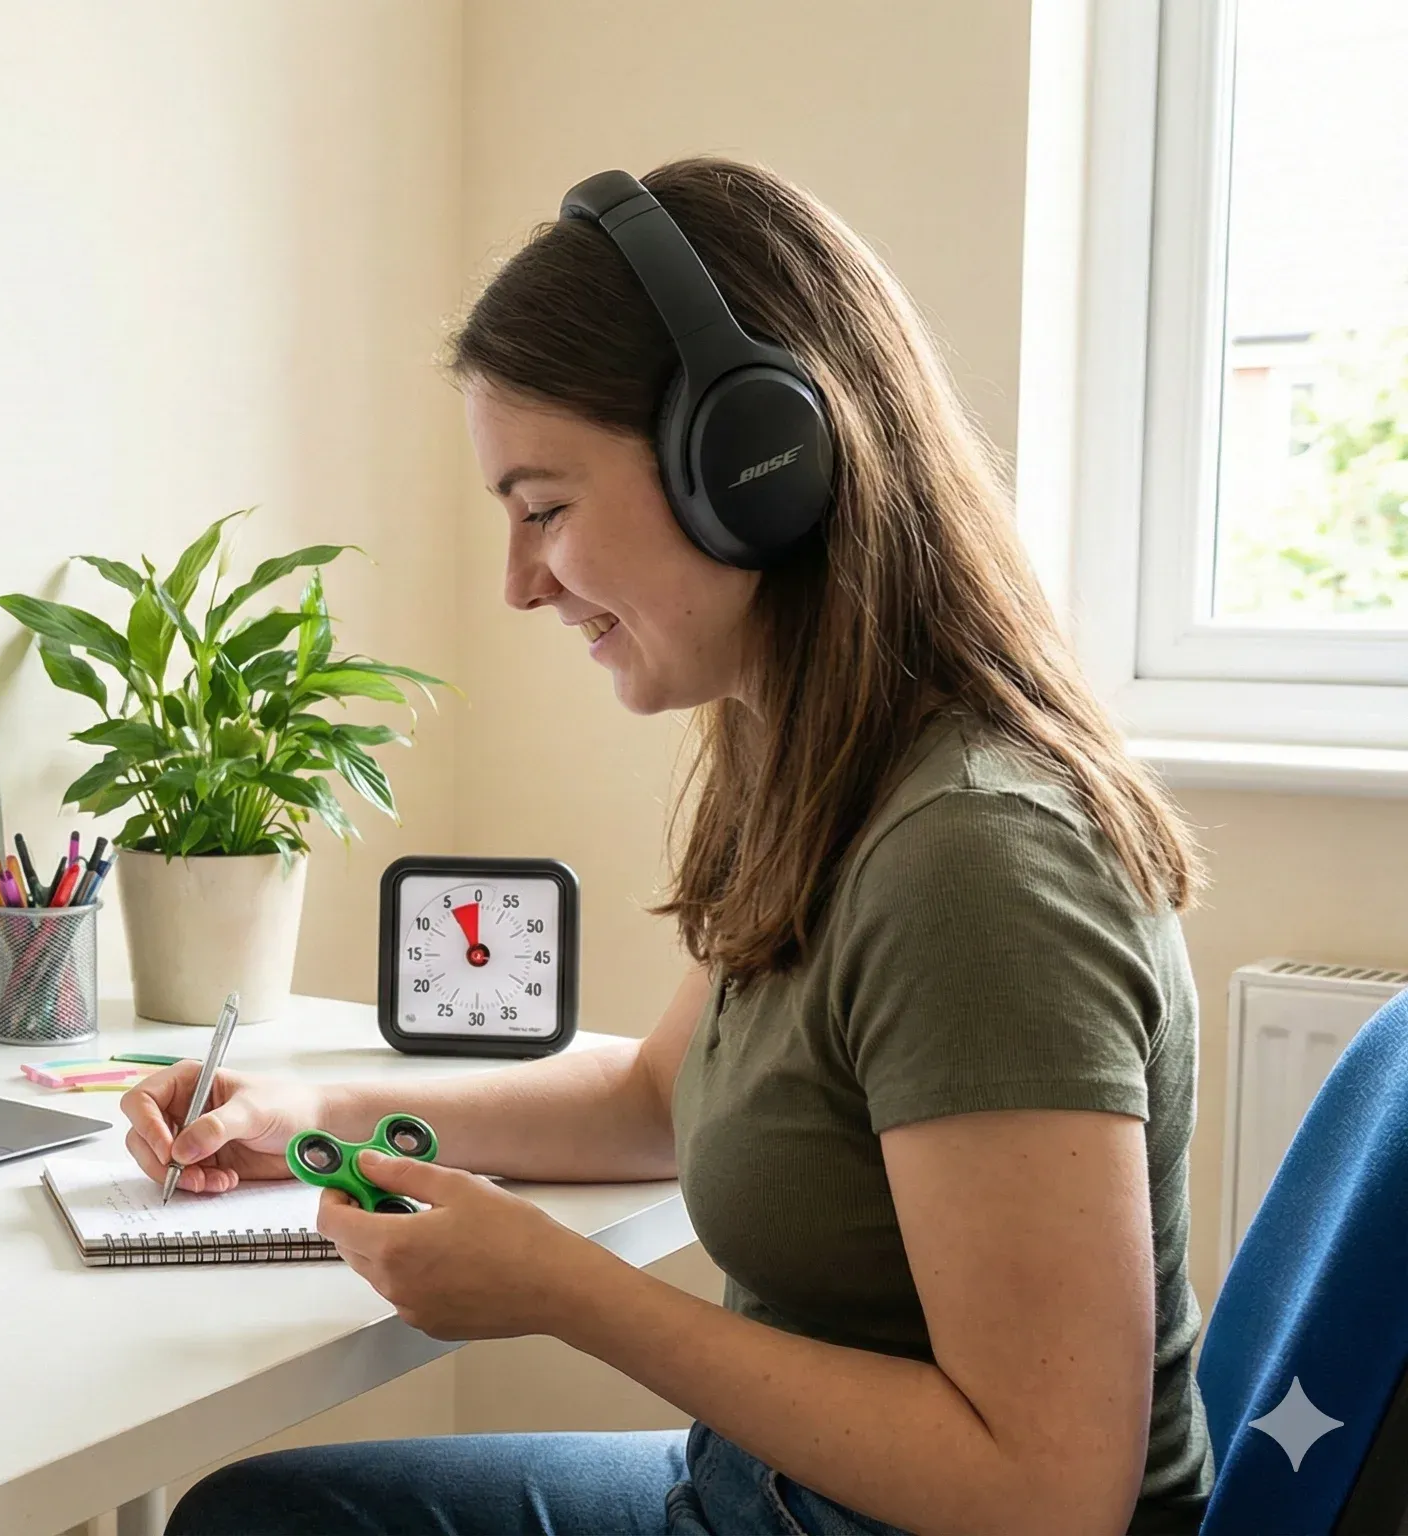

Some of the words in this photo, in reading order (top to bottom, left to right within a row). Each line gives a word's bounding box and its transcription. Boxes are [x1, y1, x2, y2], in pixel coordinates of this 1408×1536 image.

[728, 443, 804, 489] BOSE
[443, 895, 452, 909] 5
[474, 889, 483, 902] 0
[502, 894, 520, 909] 55
[416, 917, 430, 931] 10
[526, 919, 544, 933] 50
[407, 947, 422, 961] 15
[534, 951, 551, 965] 45
[413, 979, 430, 993] 20
[525, 983, 542, 997] 40
[437, 1004, 454, 1017] 25
[500, 1006, 518, 1020] 35
[468, 1012, 485, 1027] 30
